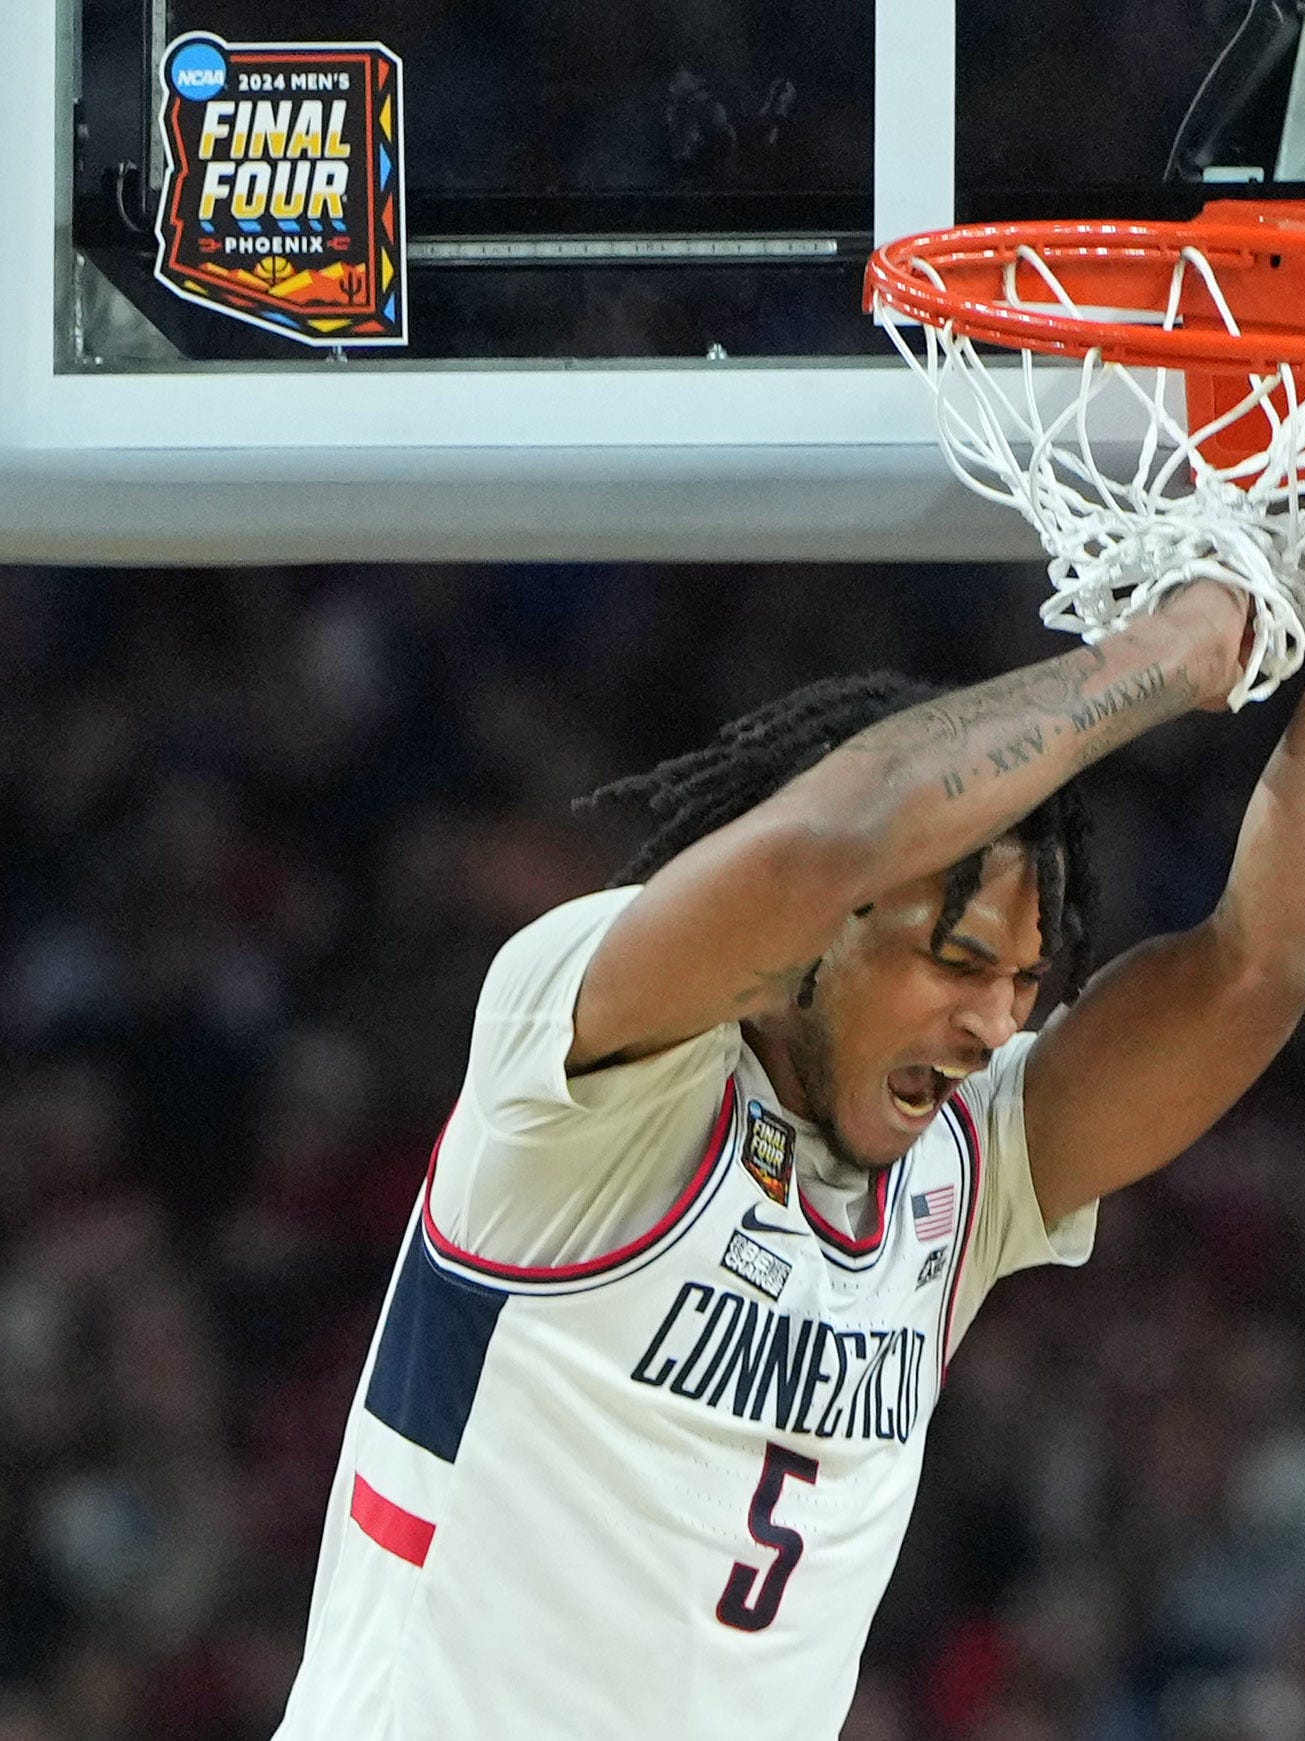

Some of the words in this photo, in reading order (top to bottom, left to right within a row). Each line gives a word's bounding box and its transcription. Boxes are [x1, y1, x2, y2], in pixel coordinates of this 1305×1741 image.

[178, 69, 225, 87] NCAA
[238, 73, 286, 91] 2024
[291, 73, 350, 91] MEN'S
[199, 100, 351, 159] FINAL
[199, 161, 349, 219] FOUR
[225, 236, 324, 255] PHOENIX
[753, 1118, 787, 1152] FINAL
[751, 1136, 785, 1171] FOUR
[716, 1441, 820, 1632] 5
